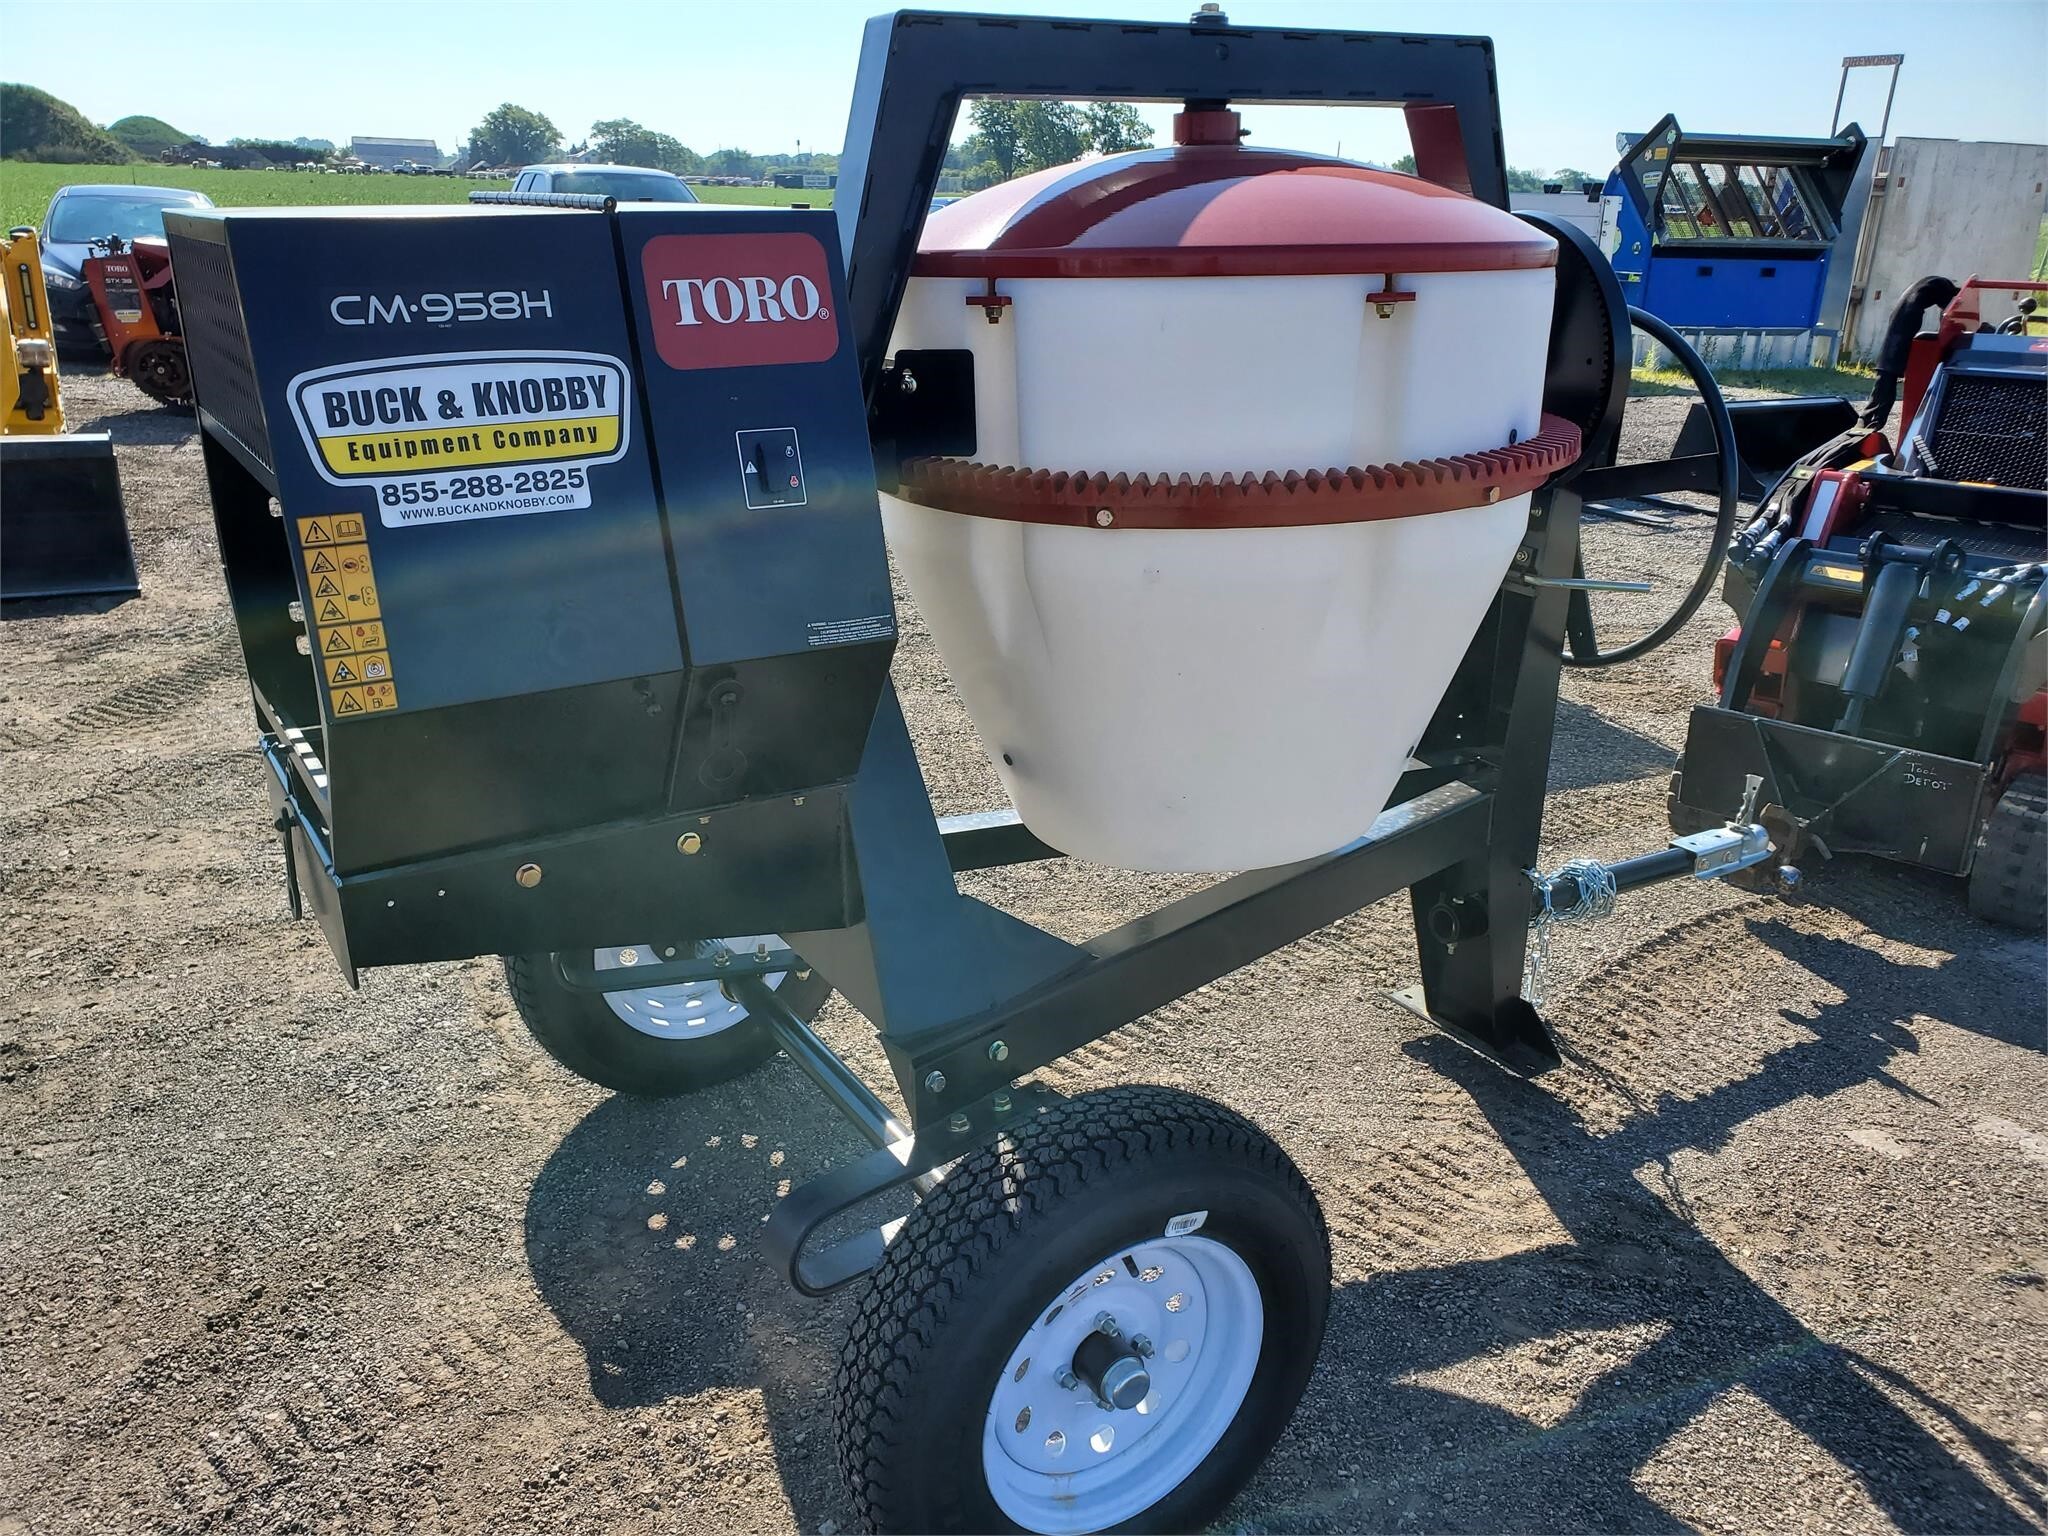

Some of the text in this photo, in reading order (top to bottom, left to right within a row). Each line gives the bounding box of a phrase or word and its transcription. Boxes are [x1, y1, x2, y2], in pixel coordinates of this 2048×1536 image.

[105, 265, 129, 273] TORO
[321, 374, 608, 429] BUCK & KNOBBY
[347, 425, 599, 462] Equipment Company
[381, 468, 585, 507] 855-288-2825
[400, 493, 576, 521] WWW.BUCKANDKNOBBY.COM
